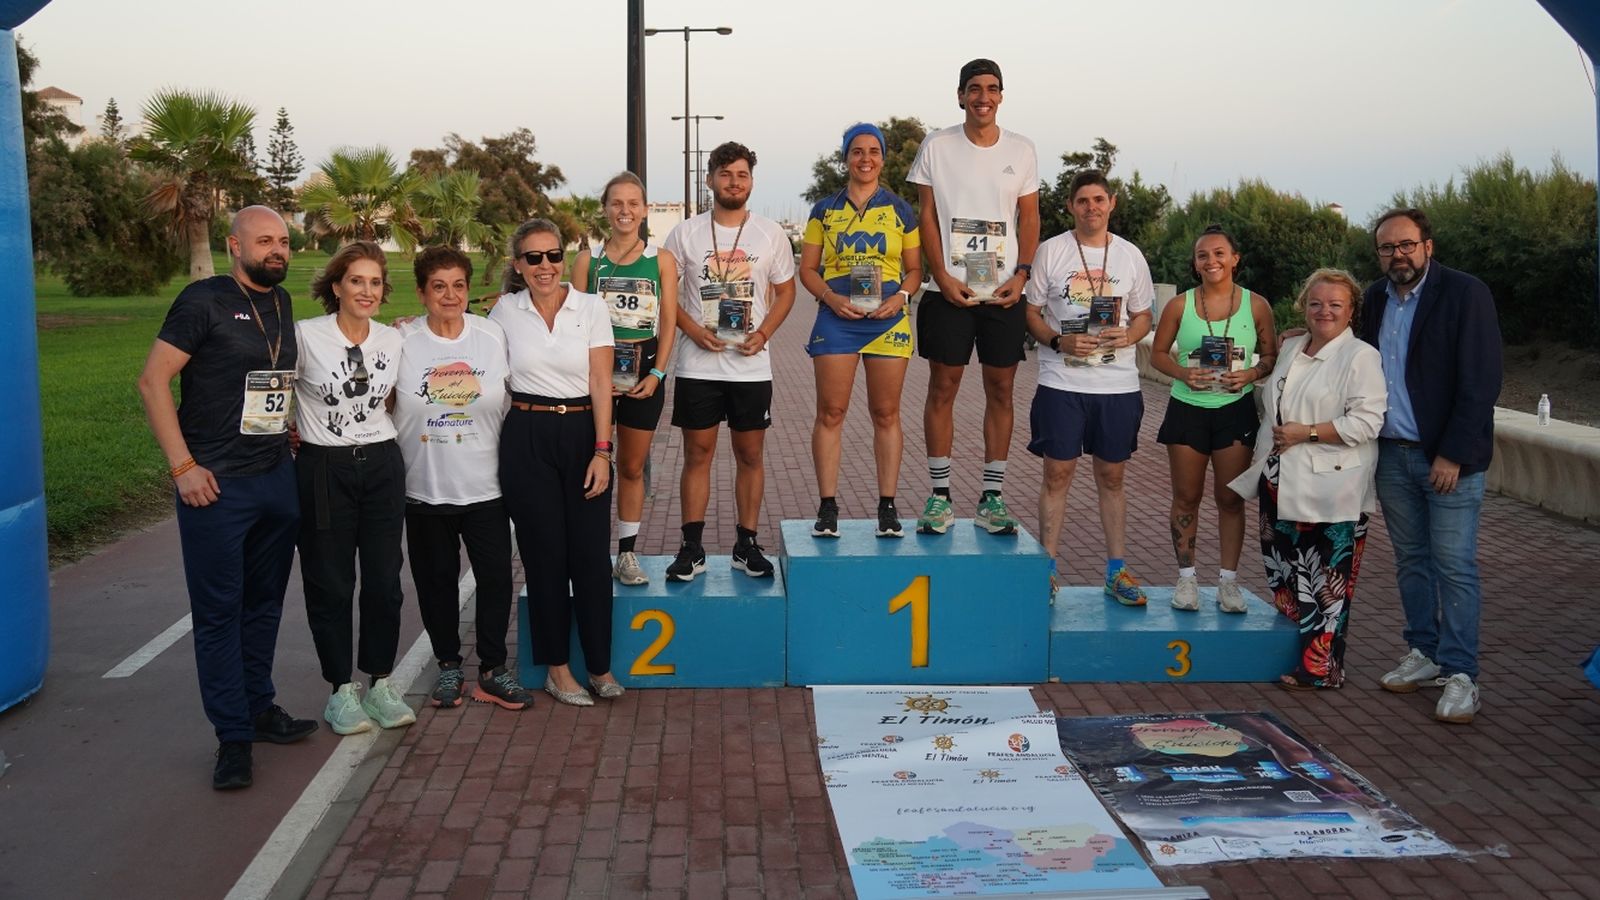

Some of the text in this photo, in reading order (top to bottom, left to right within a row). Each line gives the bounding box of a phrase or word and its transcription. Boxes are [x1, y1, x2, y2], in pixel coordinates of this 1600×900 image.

[836, 231, 887, 256] MM
[966, 235, 988, 252] 41
[615, 294, 639, 310] 38
[265, 393, 285, 413] 52
[427, 418, 474, 428] frionature
[888, 575, 930, 668] 1
[629, 609, 677, 676] 2
[1165, 640, 1193, 678] 3
[877, 714, 988, 725] El Timón
[925, 752, 969, 762] El Timón
